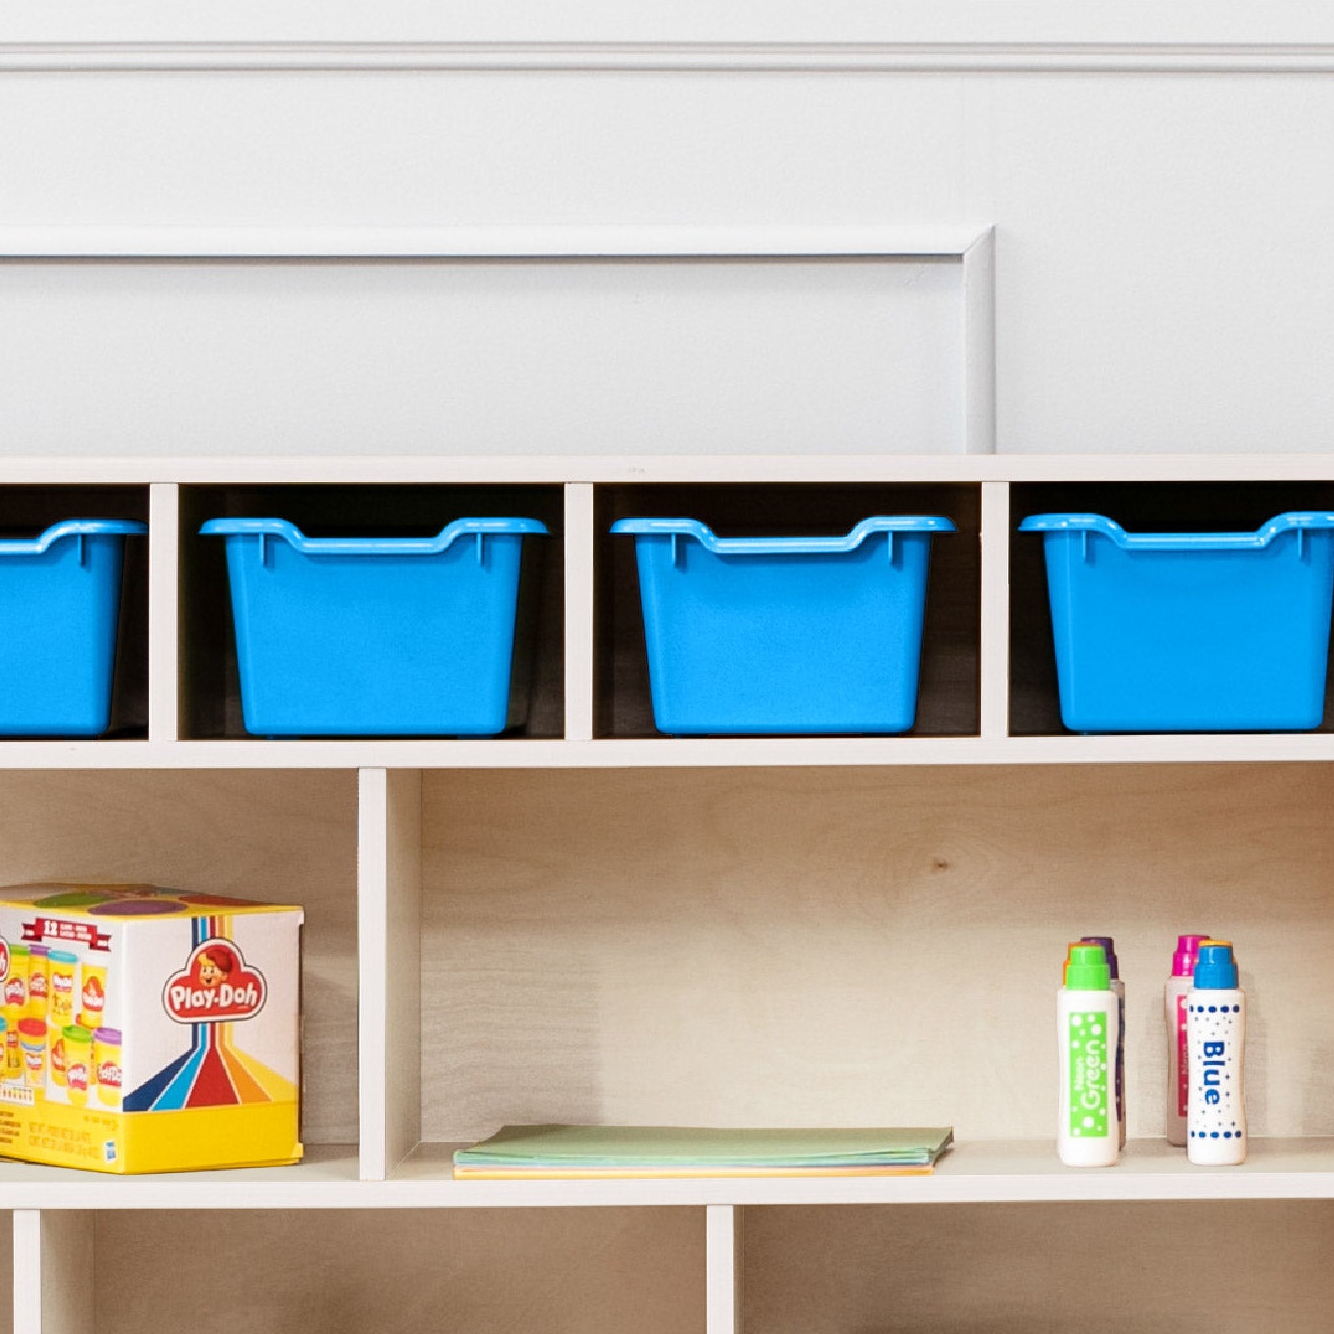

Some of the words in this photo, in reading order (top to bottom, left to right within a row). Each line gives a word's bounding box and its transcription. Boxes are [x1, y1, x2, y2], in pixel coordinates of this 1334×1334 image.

[170, 981, 258, 1011] Play-Doh
[1080, 1039, 1101, 1110] Green
[1203, 1041, 1225, 1106] Blue
